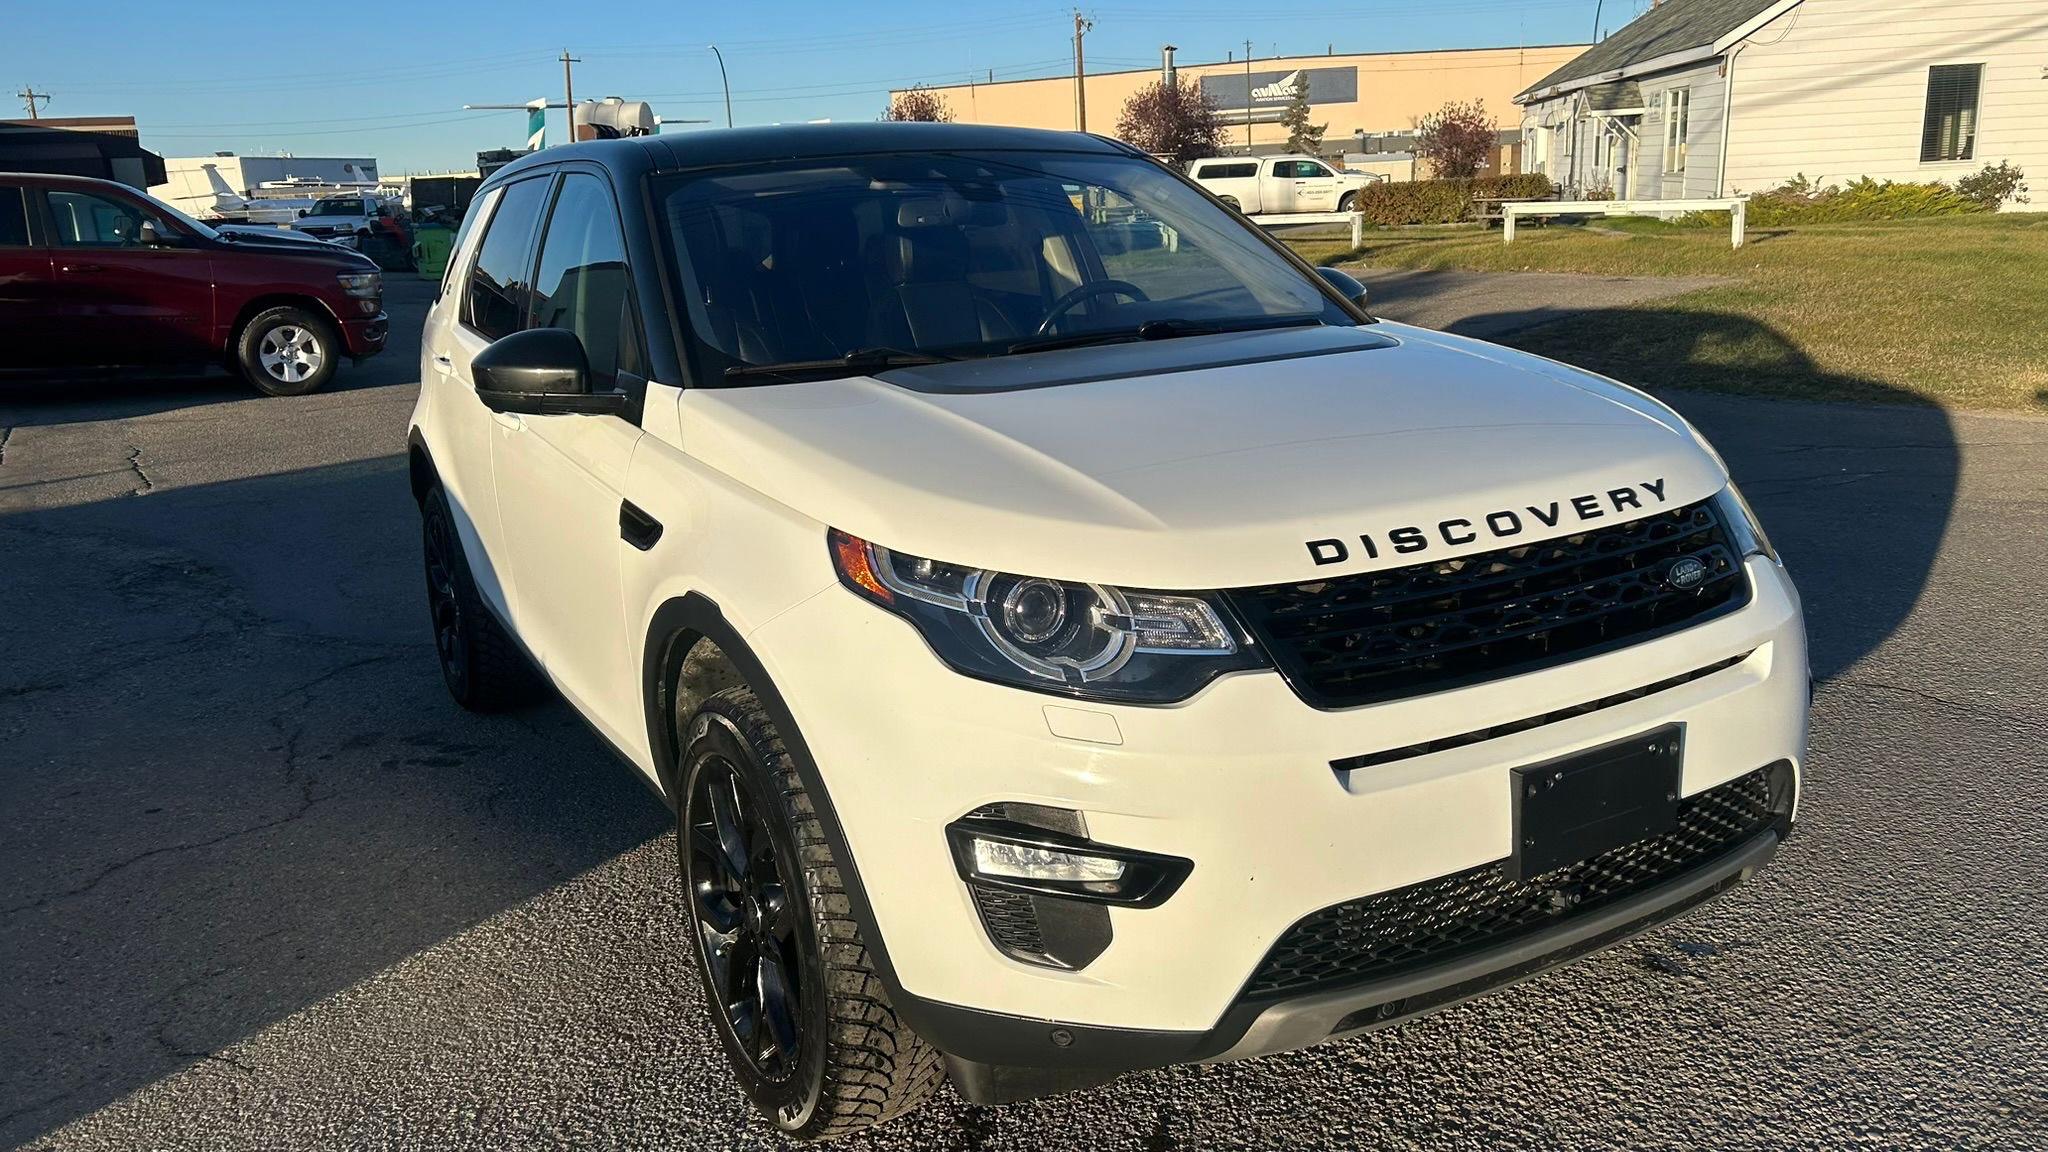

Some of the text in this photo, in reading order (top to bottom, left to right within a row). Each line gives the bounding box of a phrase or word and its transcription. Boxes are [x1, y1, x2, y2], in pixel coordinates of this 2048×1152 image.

[1305, 478, 1666, 566] DISCOVERY
[1675, 563, 1694, 577] LAND
[1680, 570, 1702, 585] ROVER
